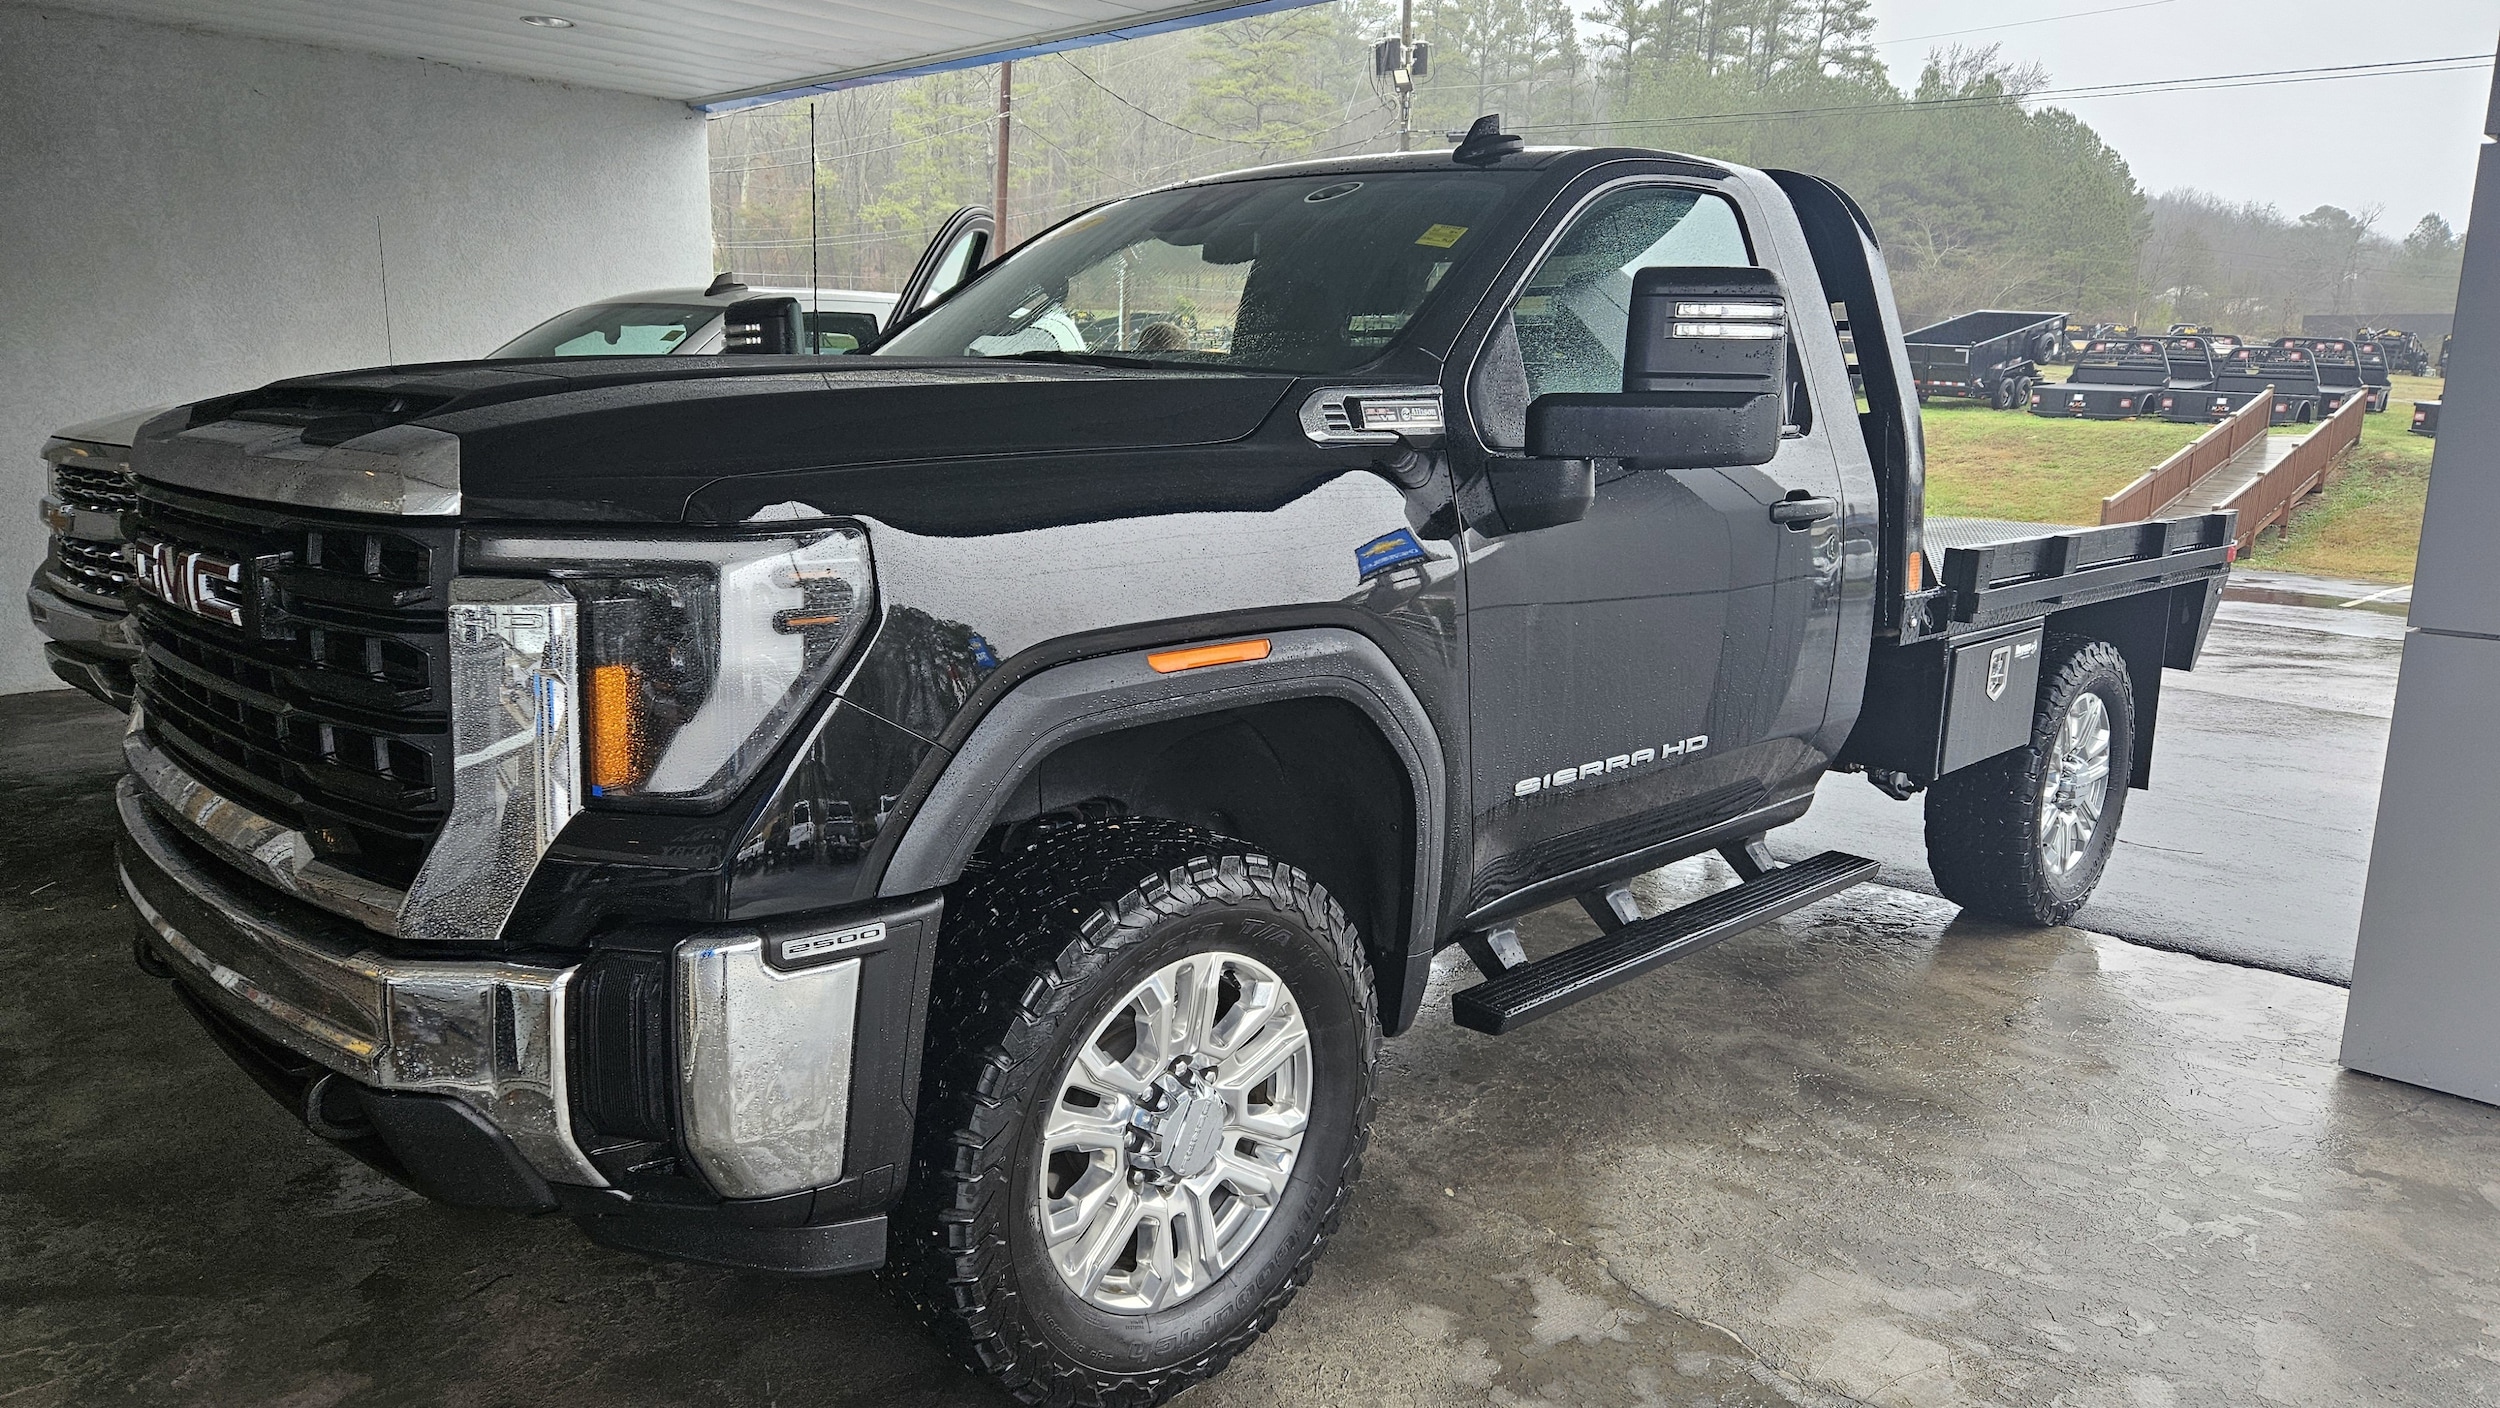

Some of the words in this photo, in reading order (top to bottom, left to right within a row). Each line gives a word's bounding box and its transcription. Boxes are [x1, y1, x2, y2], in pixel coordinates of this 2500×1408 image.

[134, 538, 243, 629] GMC
[1514, 748, 1655, 796] SIERRA
[1661, 735, 1708, 759] HD
[788, 929, 880, 954] 2500
